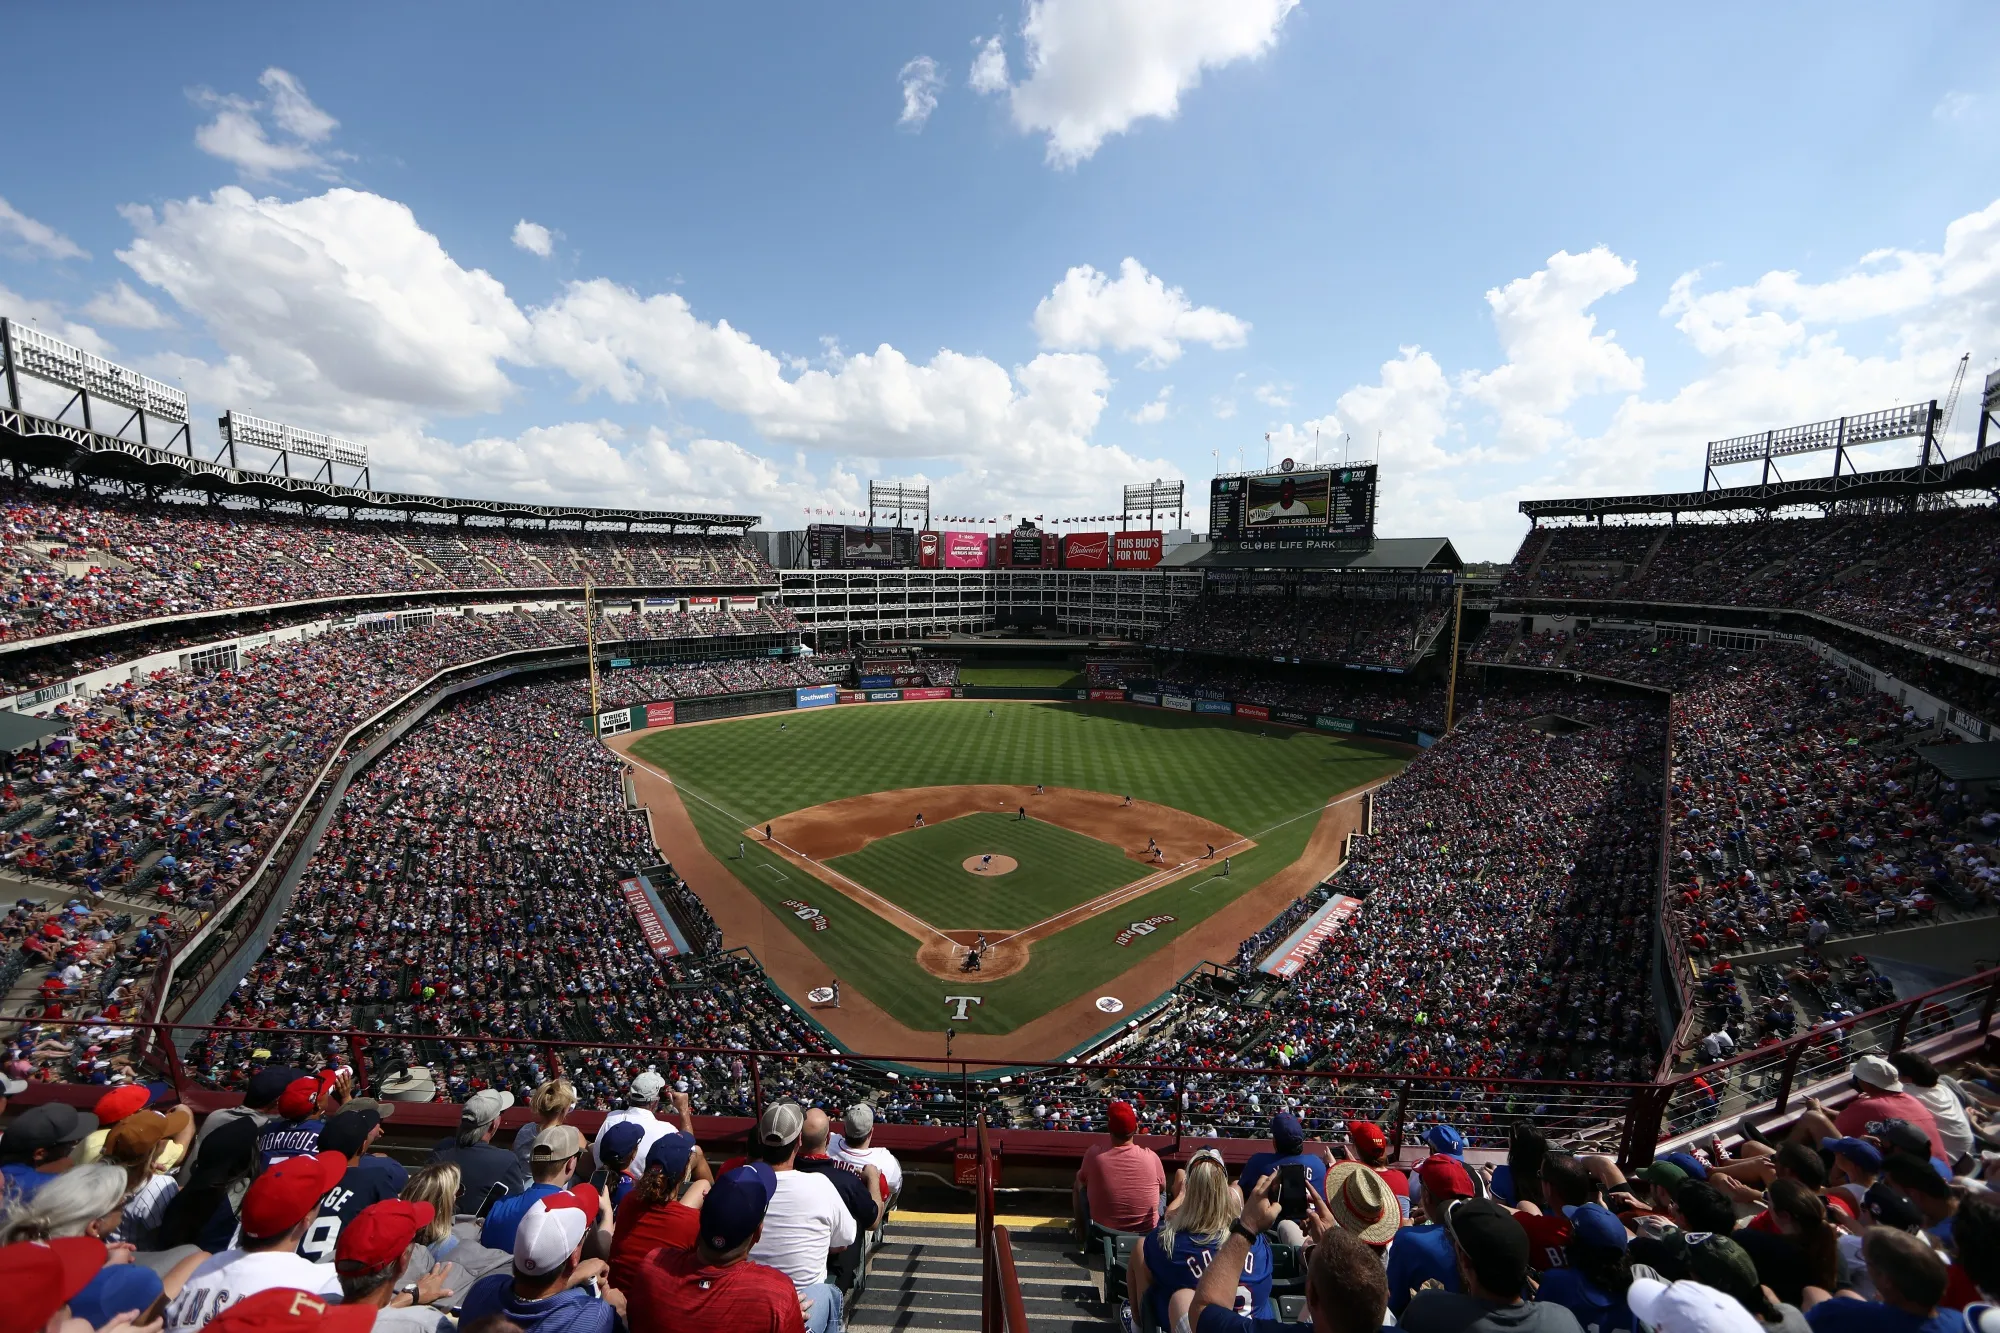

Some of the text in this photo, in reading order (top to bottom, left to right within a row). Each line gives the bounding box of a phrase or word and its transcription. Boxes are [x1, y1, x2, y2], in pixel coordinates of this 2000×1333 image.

[1014, 528, 1040, 538] Coca-Cola
[1116, 538, 1159, 549] THIS BUD'S
[1240, 540, 1336, 550] GLOBE LIFE PARK
[1070, 545, 1103, 554] Budweiser
[1116, 550, 1150, 560] FOR YOU.
[1280, 572, 1307, 582] PAINS
[40, 686, 54, 702] 1270
[56, 683, 66, 696] AM
[800, 693, 829, 702] Southwest
[1206, 690, 1224, 700] Mitel
[1166, 698, 1188, 708] Snapple
[603, 712, 628, 721] TRUCK
[603, 716, 628, 726] WORLD
[1324, 720, 1353, 729] National
[628, 892, 651, 913] TEXAS
[1144, 916, 1174, 926] 2019
[1314, 906, 1351, 936] RANGERS
[640, 912, 668, 944] RANGERS
[1116, 930, 1136, 946] 1994
[1290, 934, 1324, 959] TEXAS
[944, 996, 984, 1021] T
[1451, 1140, 1459, 1150] T
[1186, 1250, 1254, 1278] GAO
[289, 1292, 326, 1316] T
